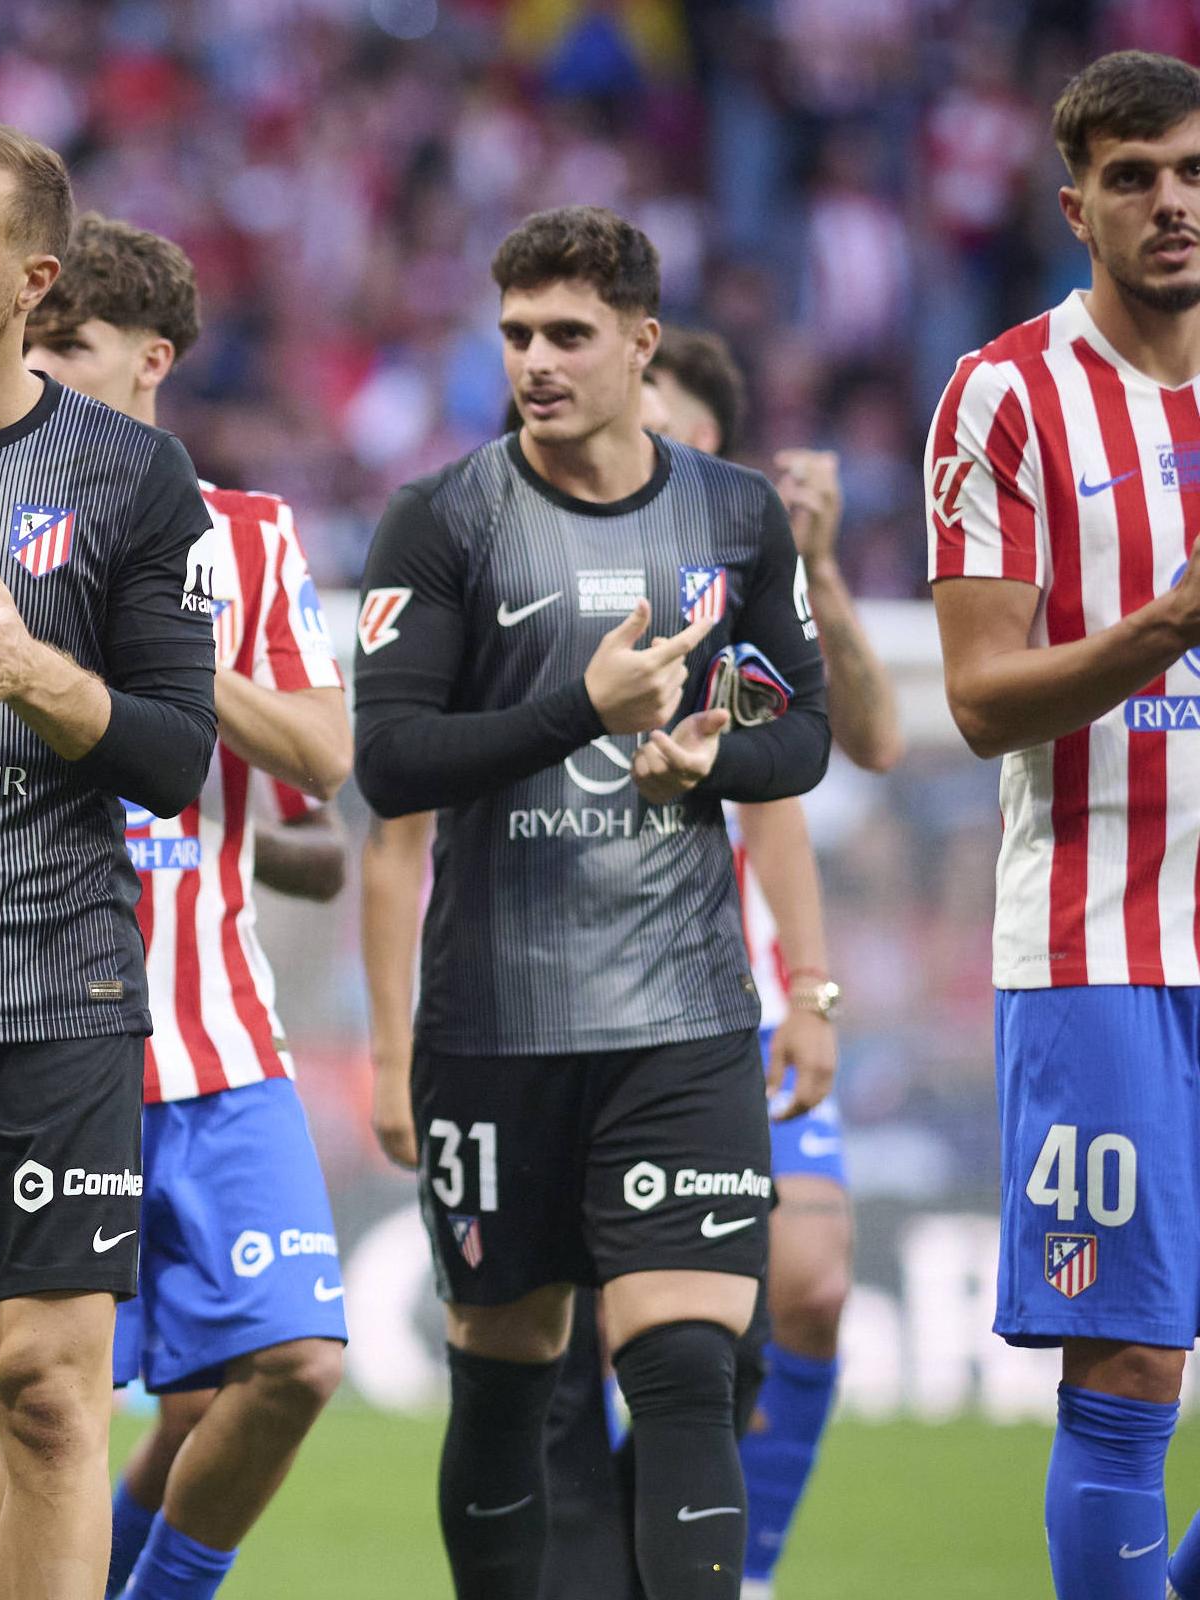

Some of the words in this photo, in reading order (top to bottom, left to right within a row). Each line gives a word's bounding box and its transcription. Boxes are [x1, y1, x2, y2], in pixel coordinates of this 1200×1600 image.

[1133, 699, 1200, 727] RIYA
[509, 807, 632, 841] RIYADH
[639, 803, 686, 836] AIR
[428, 1118, 498, 1212] 31
[673, 1167, 773, 1199] ComAve
[1025, 1124, 1137, 1228] 40
